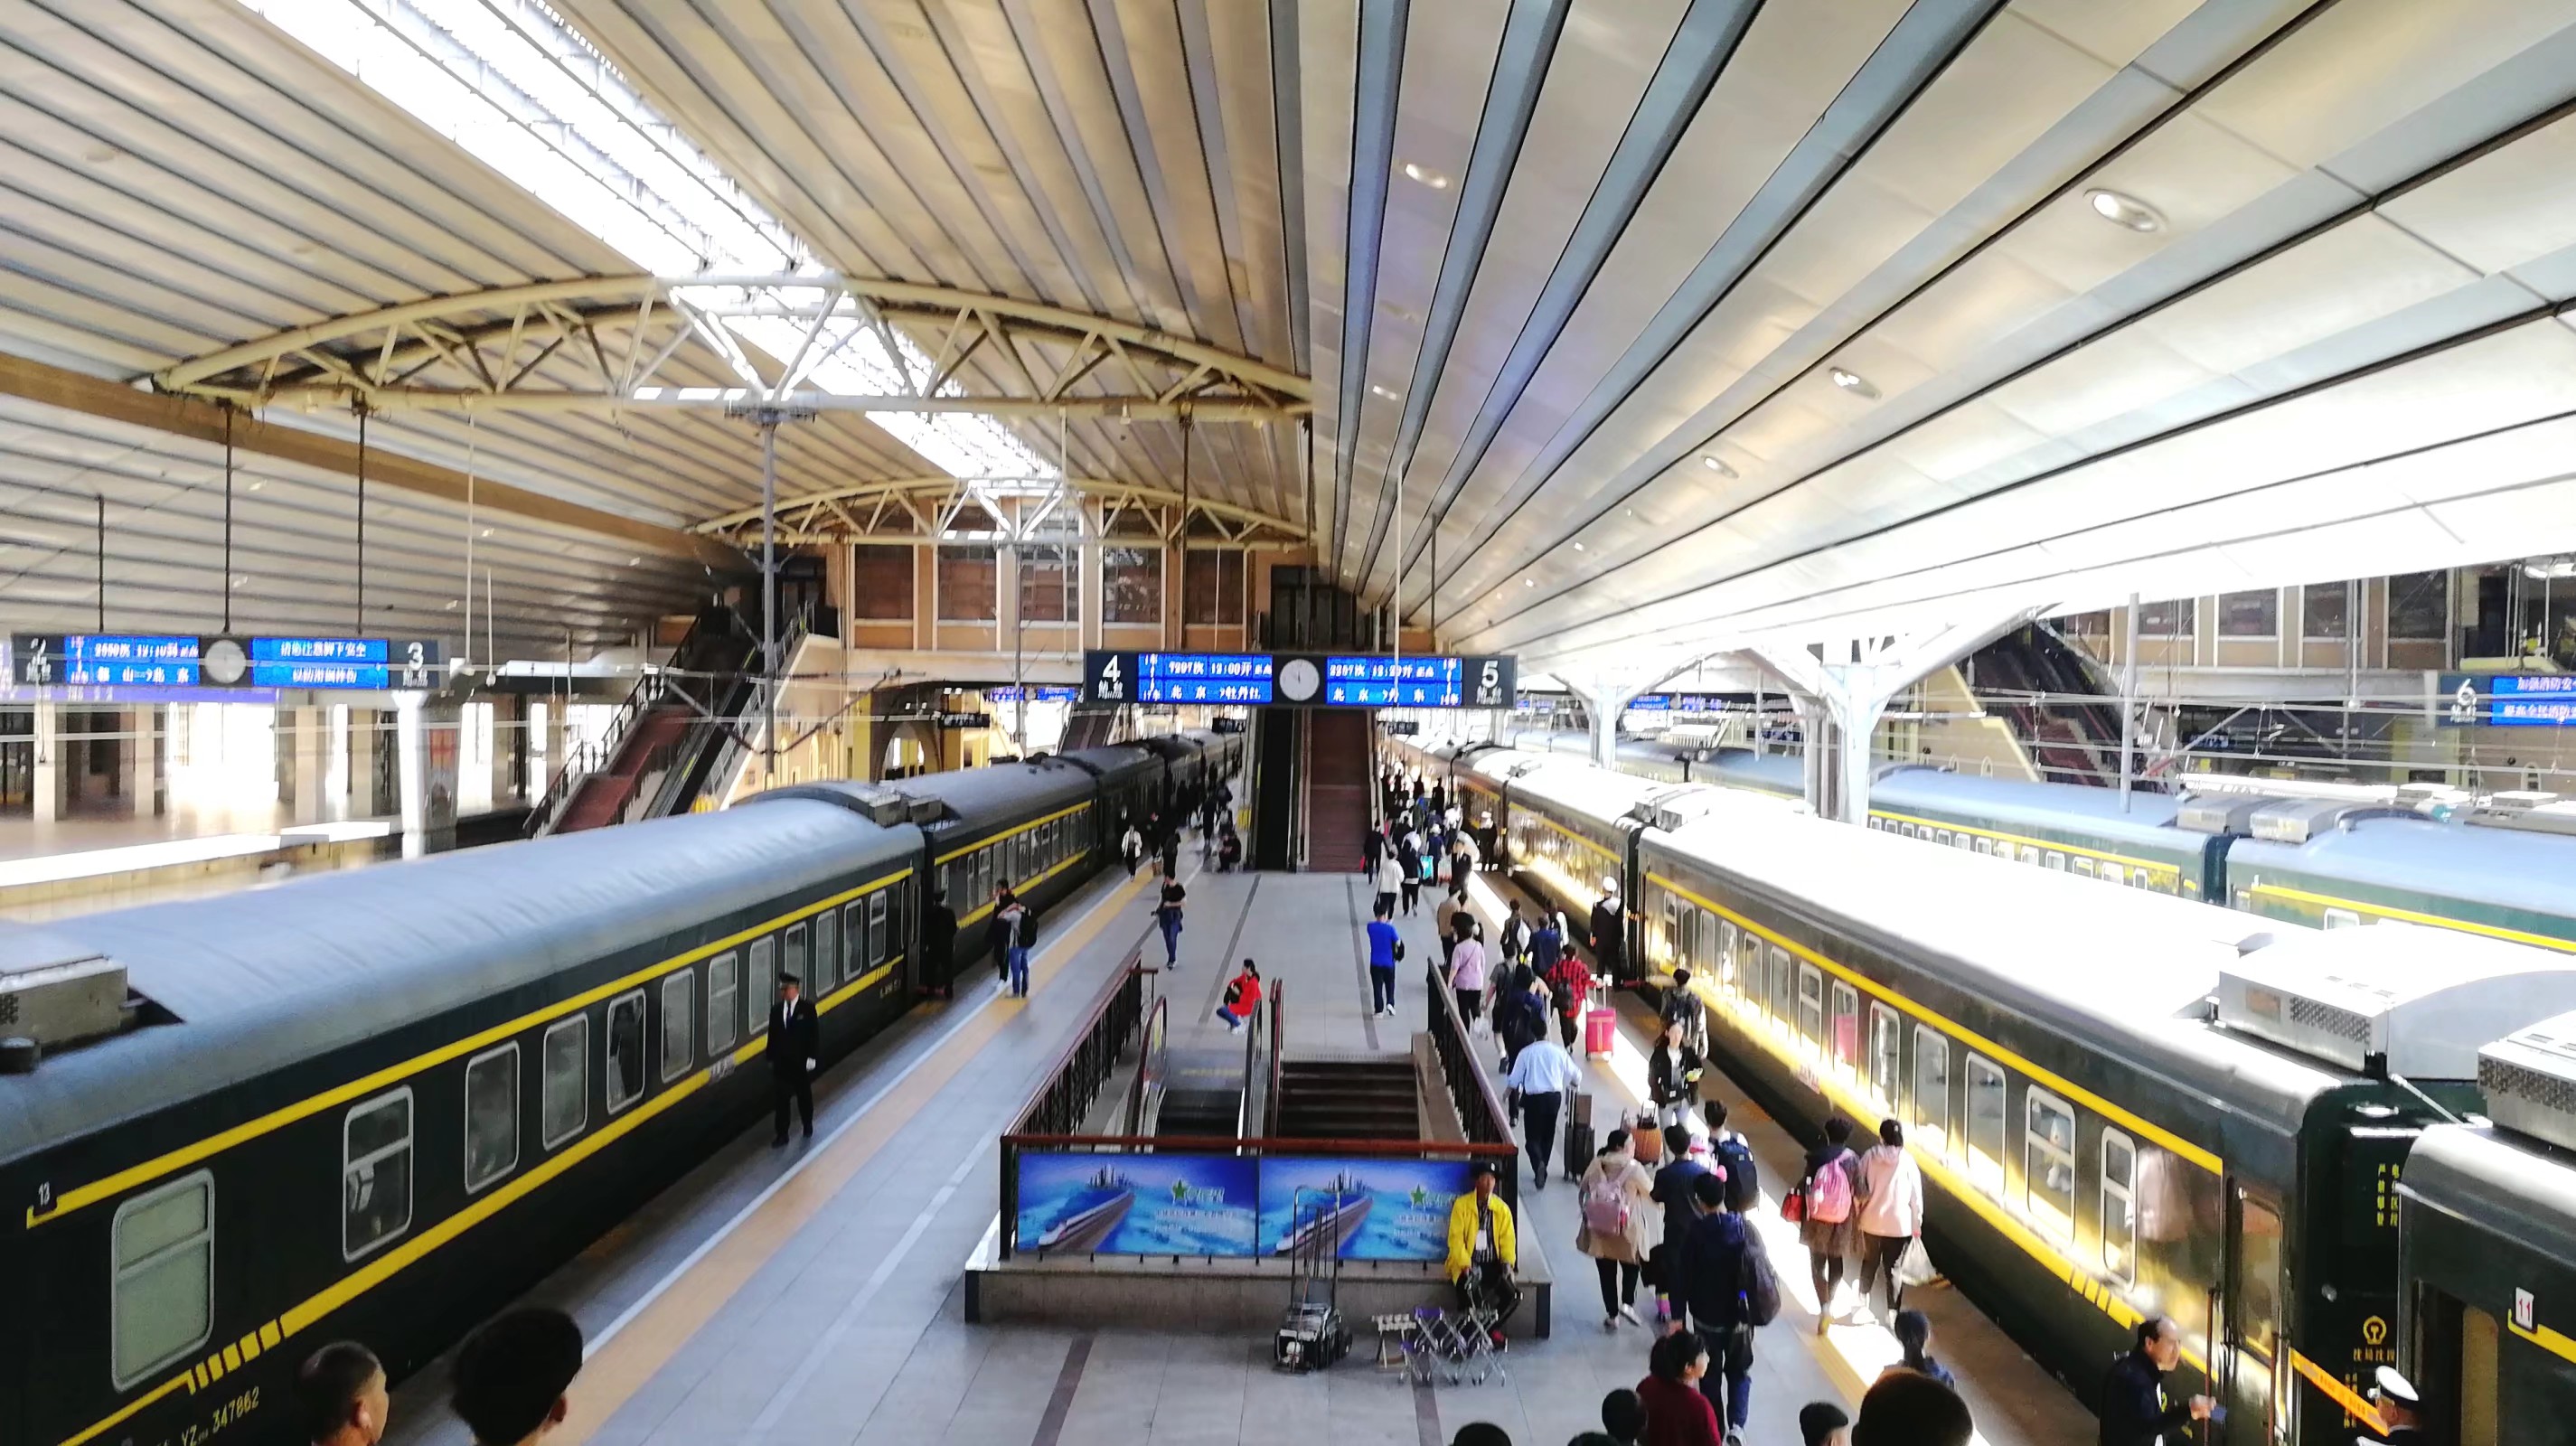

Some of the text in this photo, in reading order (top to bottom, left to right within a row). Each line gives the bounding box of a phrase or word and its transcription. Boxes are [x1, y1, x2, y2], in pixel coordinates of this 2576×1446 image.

[407, 642, 424, 670] 3
[1102, 654, 1121, 682] 4
[1481, 660, 1500, 688] 5
[2516, 676, 2576, 691] 加强消防安
[2457, 678, 2477, 706] 6
[38, 1181, 51, 1207] 13
[2518, 1297, 2531, 1322] 11
